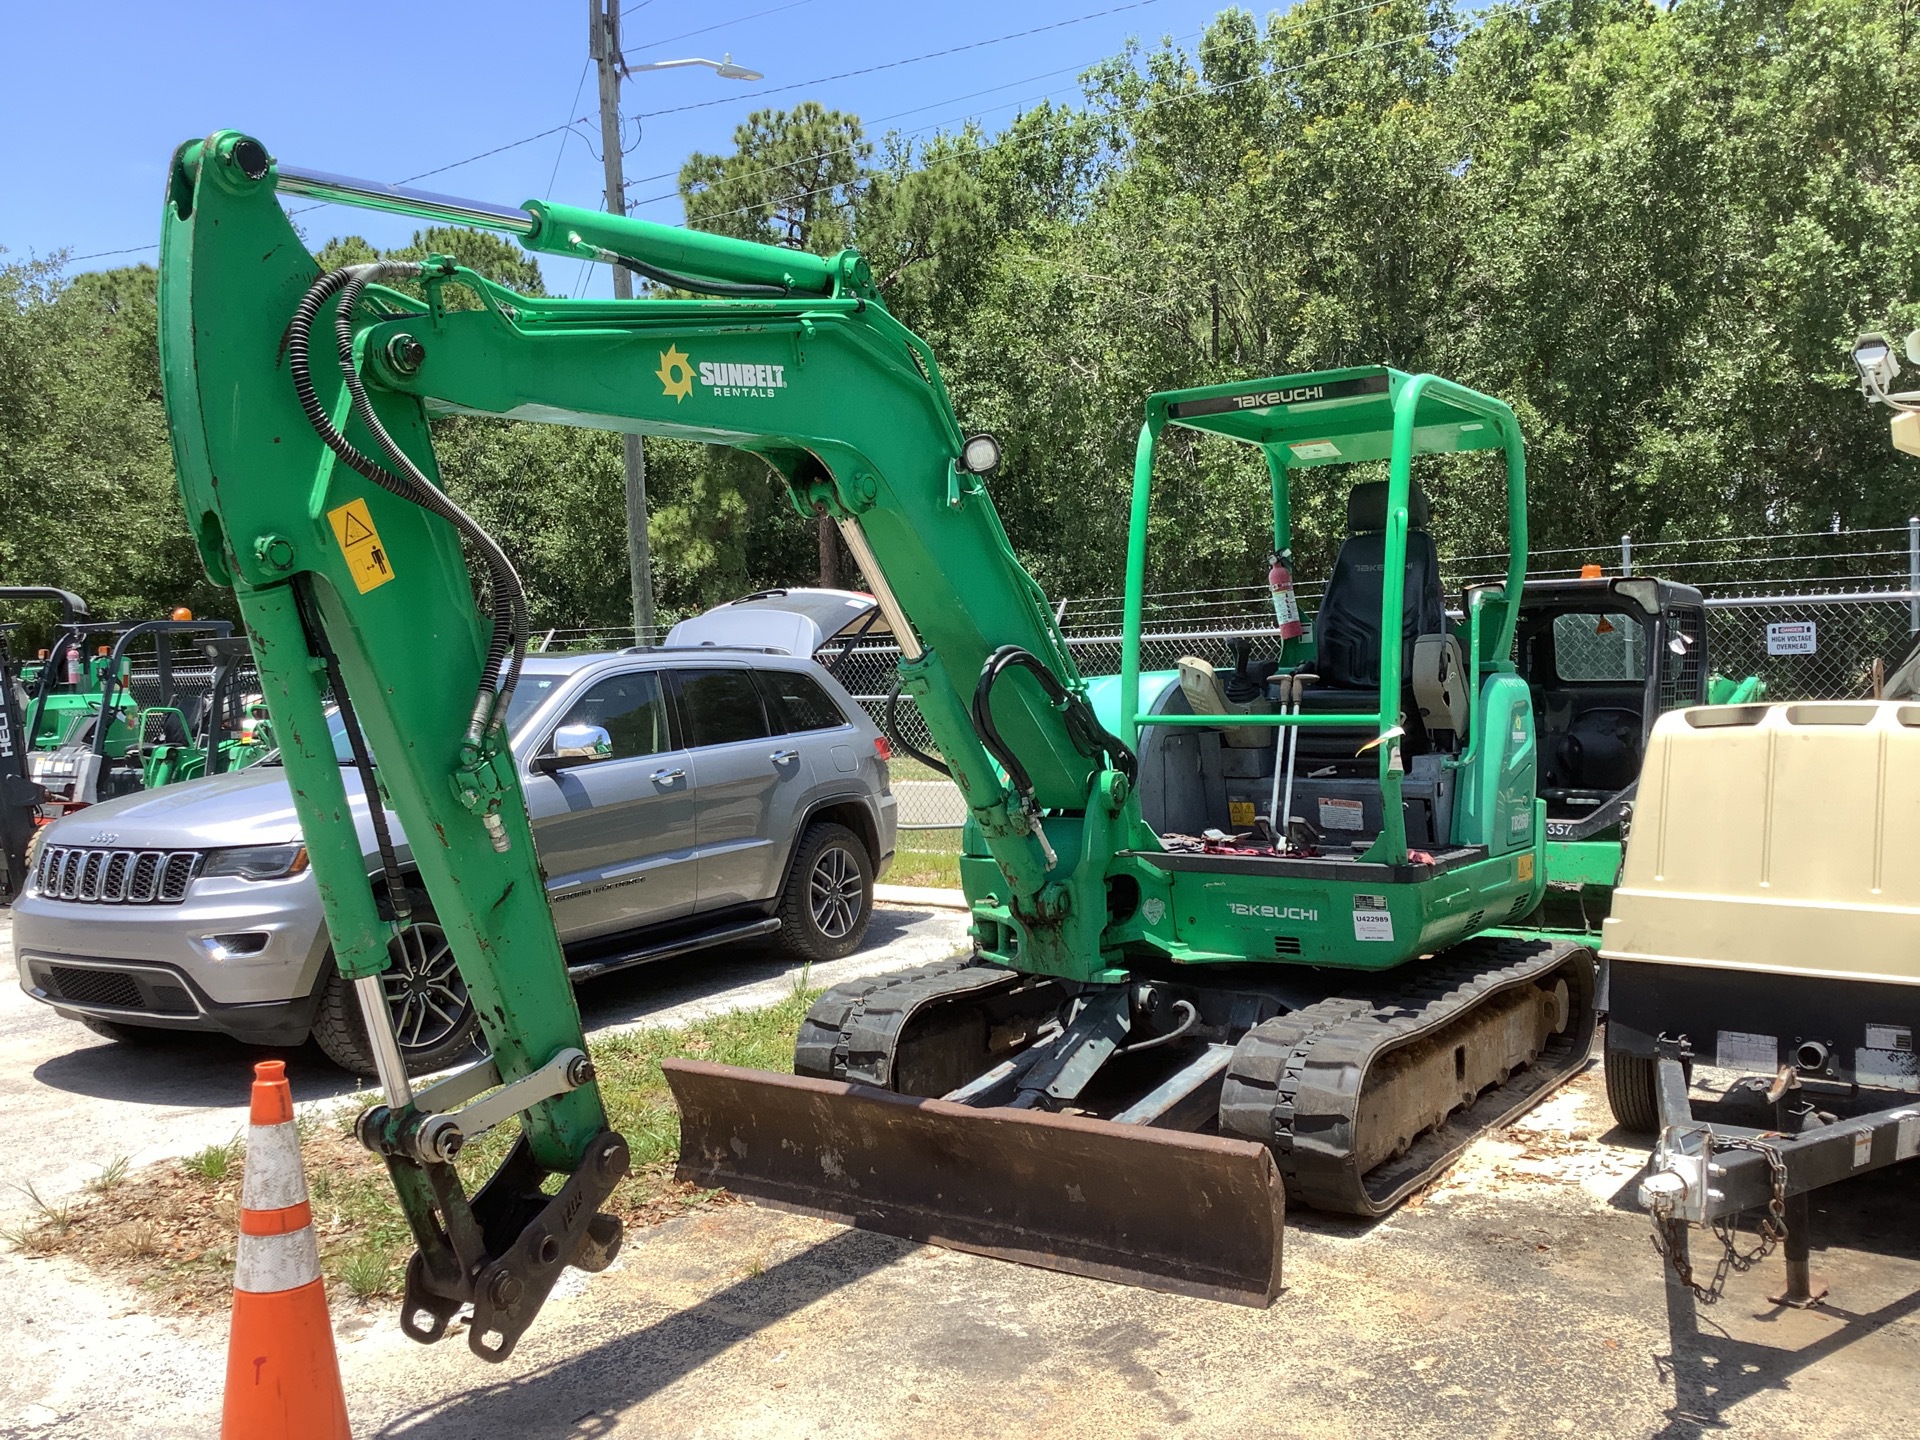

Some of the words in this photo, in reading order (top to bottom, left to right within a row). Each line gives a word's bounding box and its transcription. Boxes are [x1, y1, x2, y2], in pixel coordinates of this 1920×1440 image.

[699, 362, 784, 388] SUNBELT
[714, 388, 775, 398] RENTALS
[1233, 386, 1324, 408] TAKEUCHI
